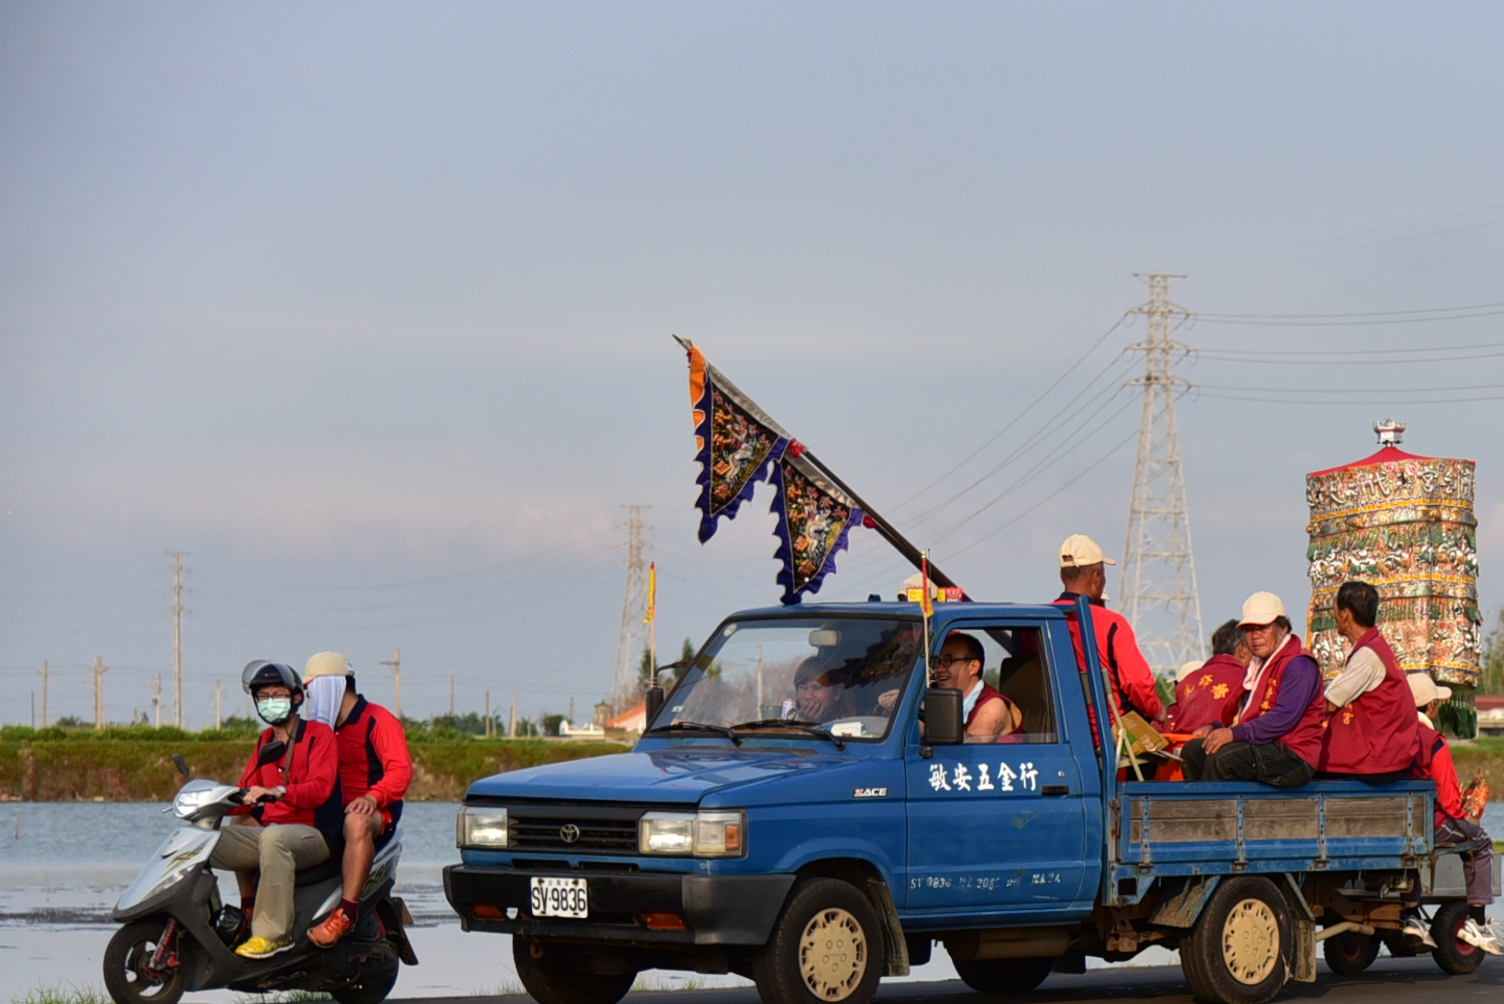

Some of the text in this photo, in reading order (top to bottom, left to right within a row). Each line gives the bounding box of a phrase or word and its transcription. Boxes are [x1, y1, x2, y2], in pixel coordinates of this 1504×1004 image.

[928, 762, 1040, 792] 敏安五金行
[853, 787, 888, 798] ZACE
[532, 887, 586, 912] SV-9836
